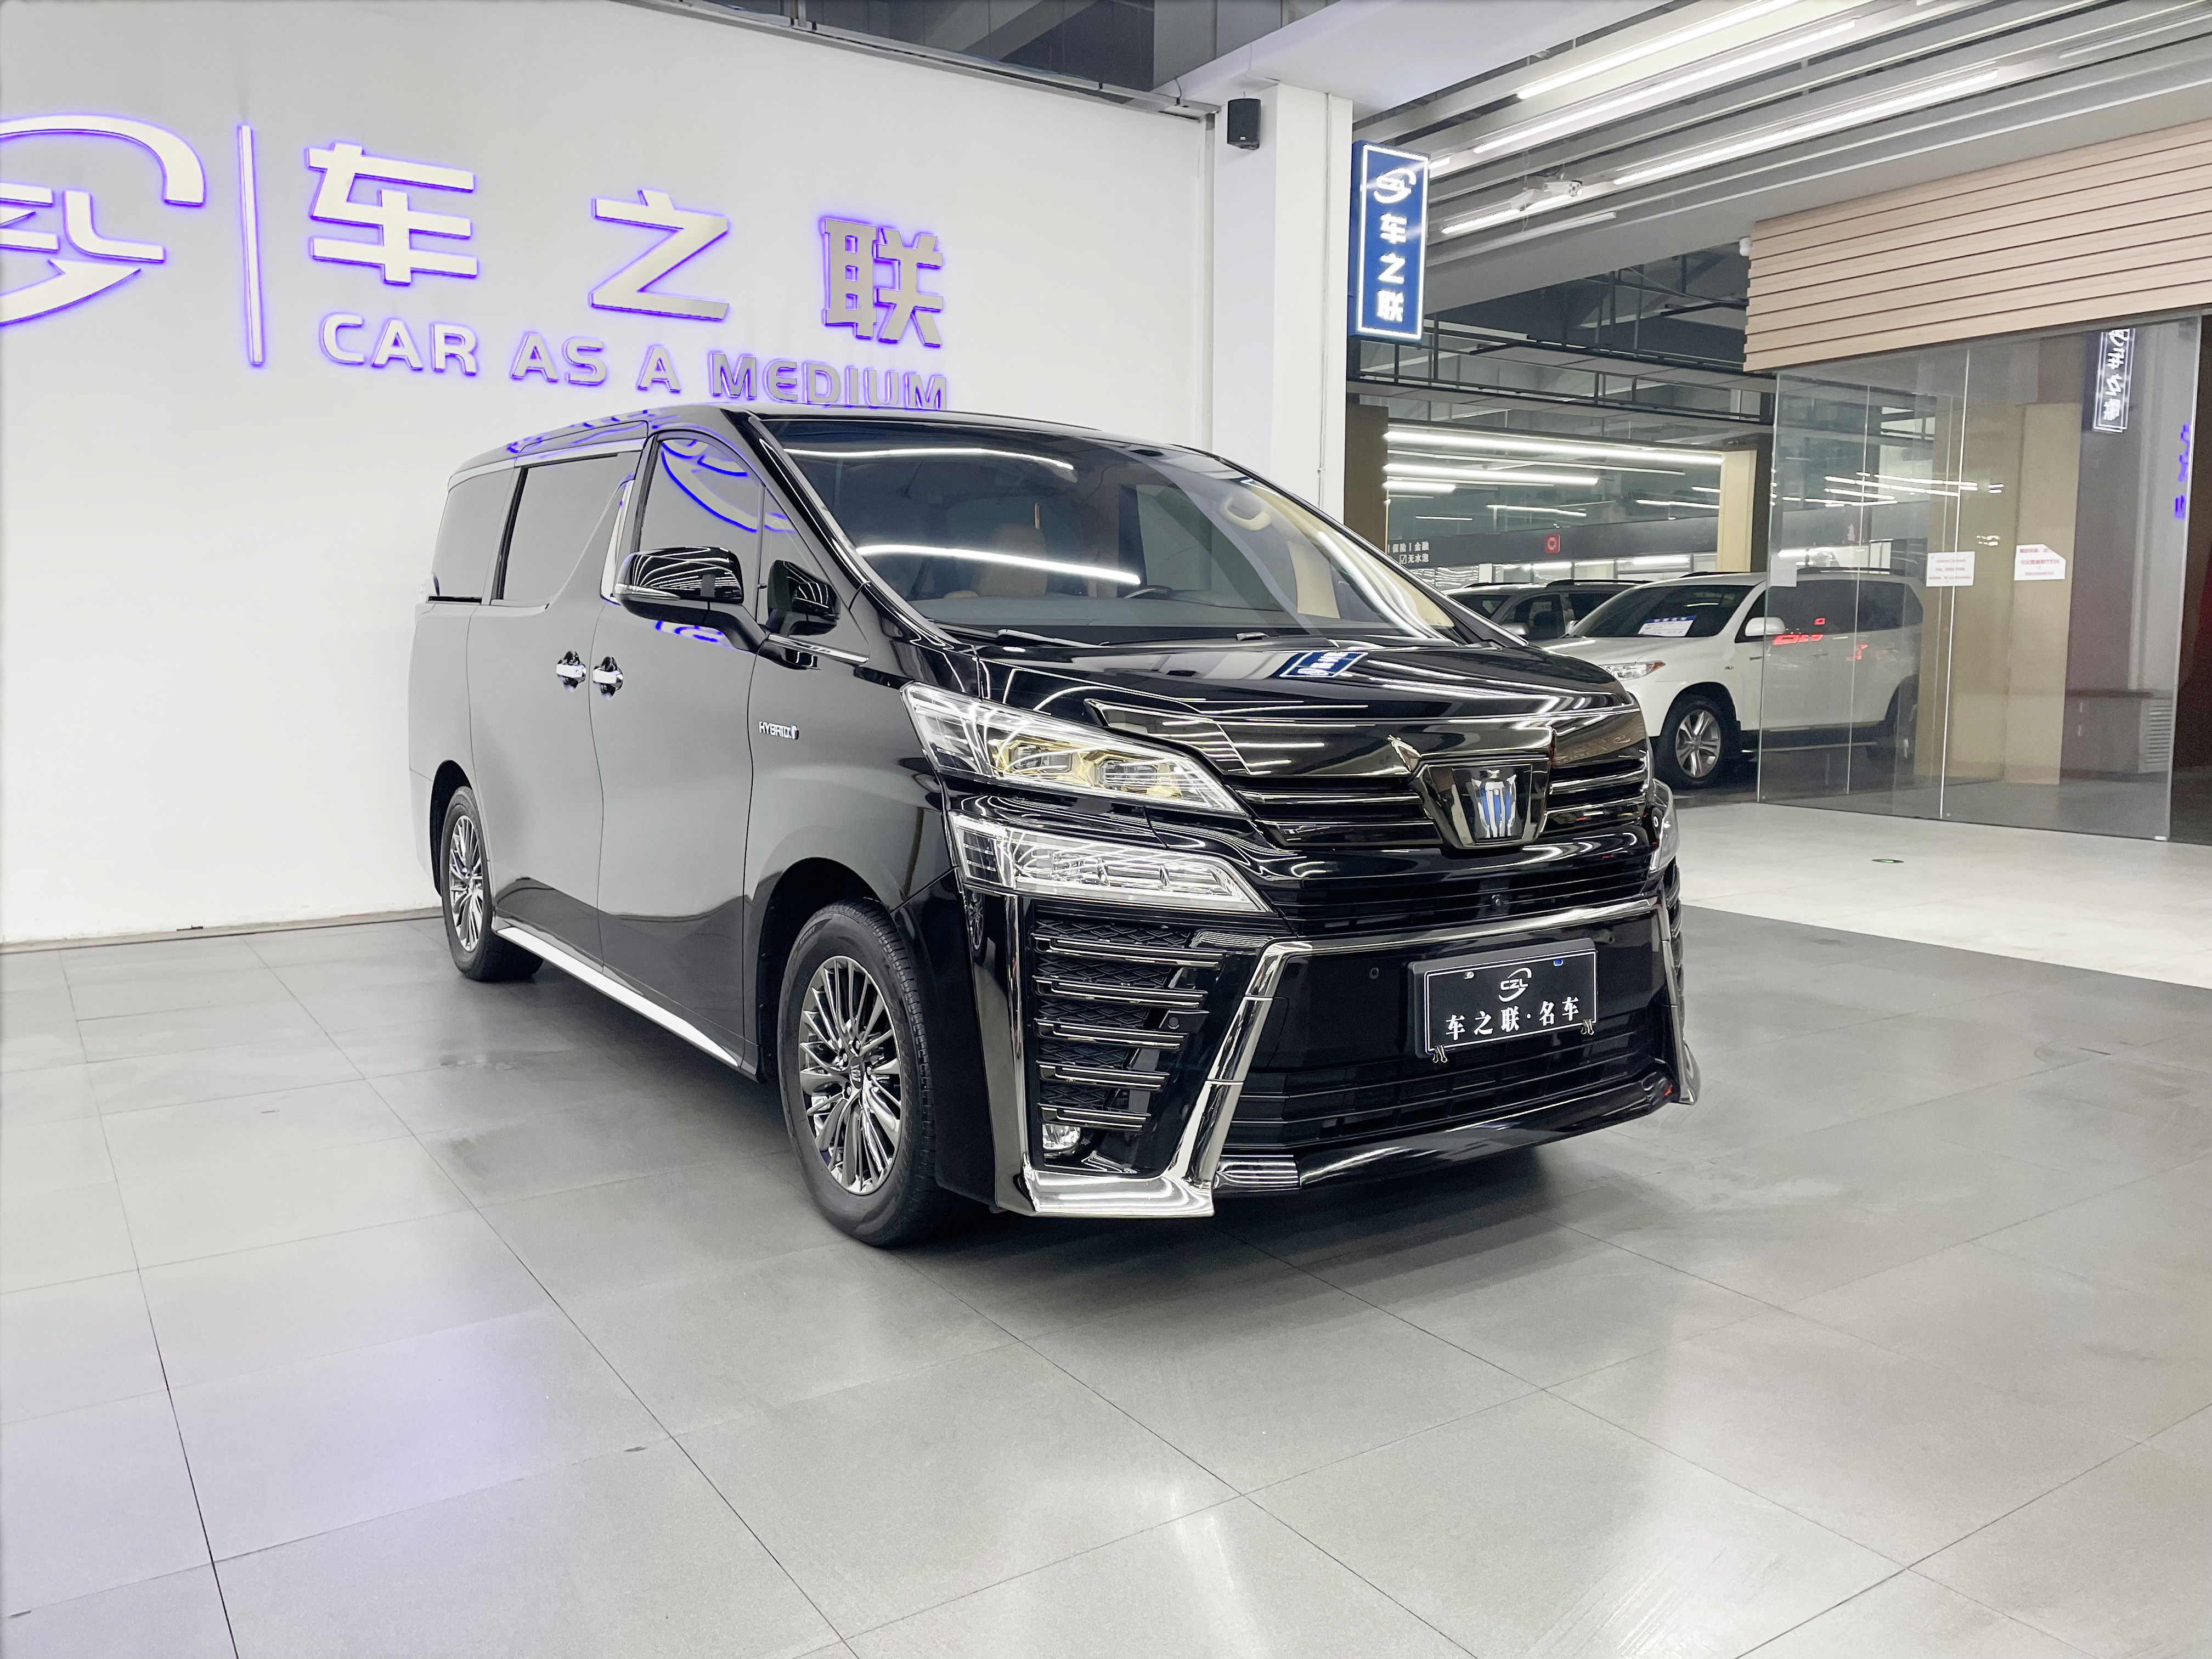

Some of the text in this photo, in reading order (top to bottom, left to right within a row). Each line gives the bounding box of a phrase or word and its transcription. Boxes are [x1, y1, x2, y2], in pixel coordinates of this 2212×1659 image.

[306, 140, 945, 347] 车之联
[1378, 213, 1407, 322] 车之联
[319, 313, 947, 410] CAR AS A MEDIUM
[759, 721, 791, 738] HYBRID
